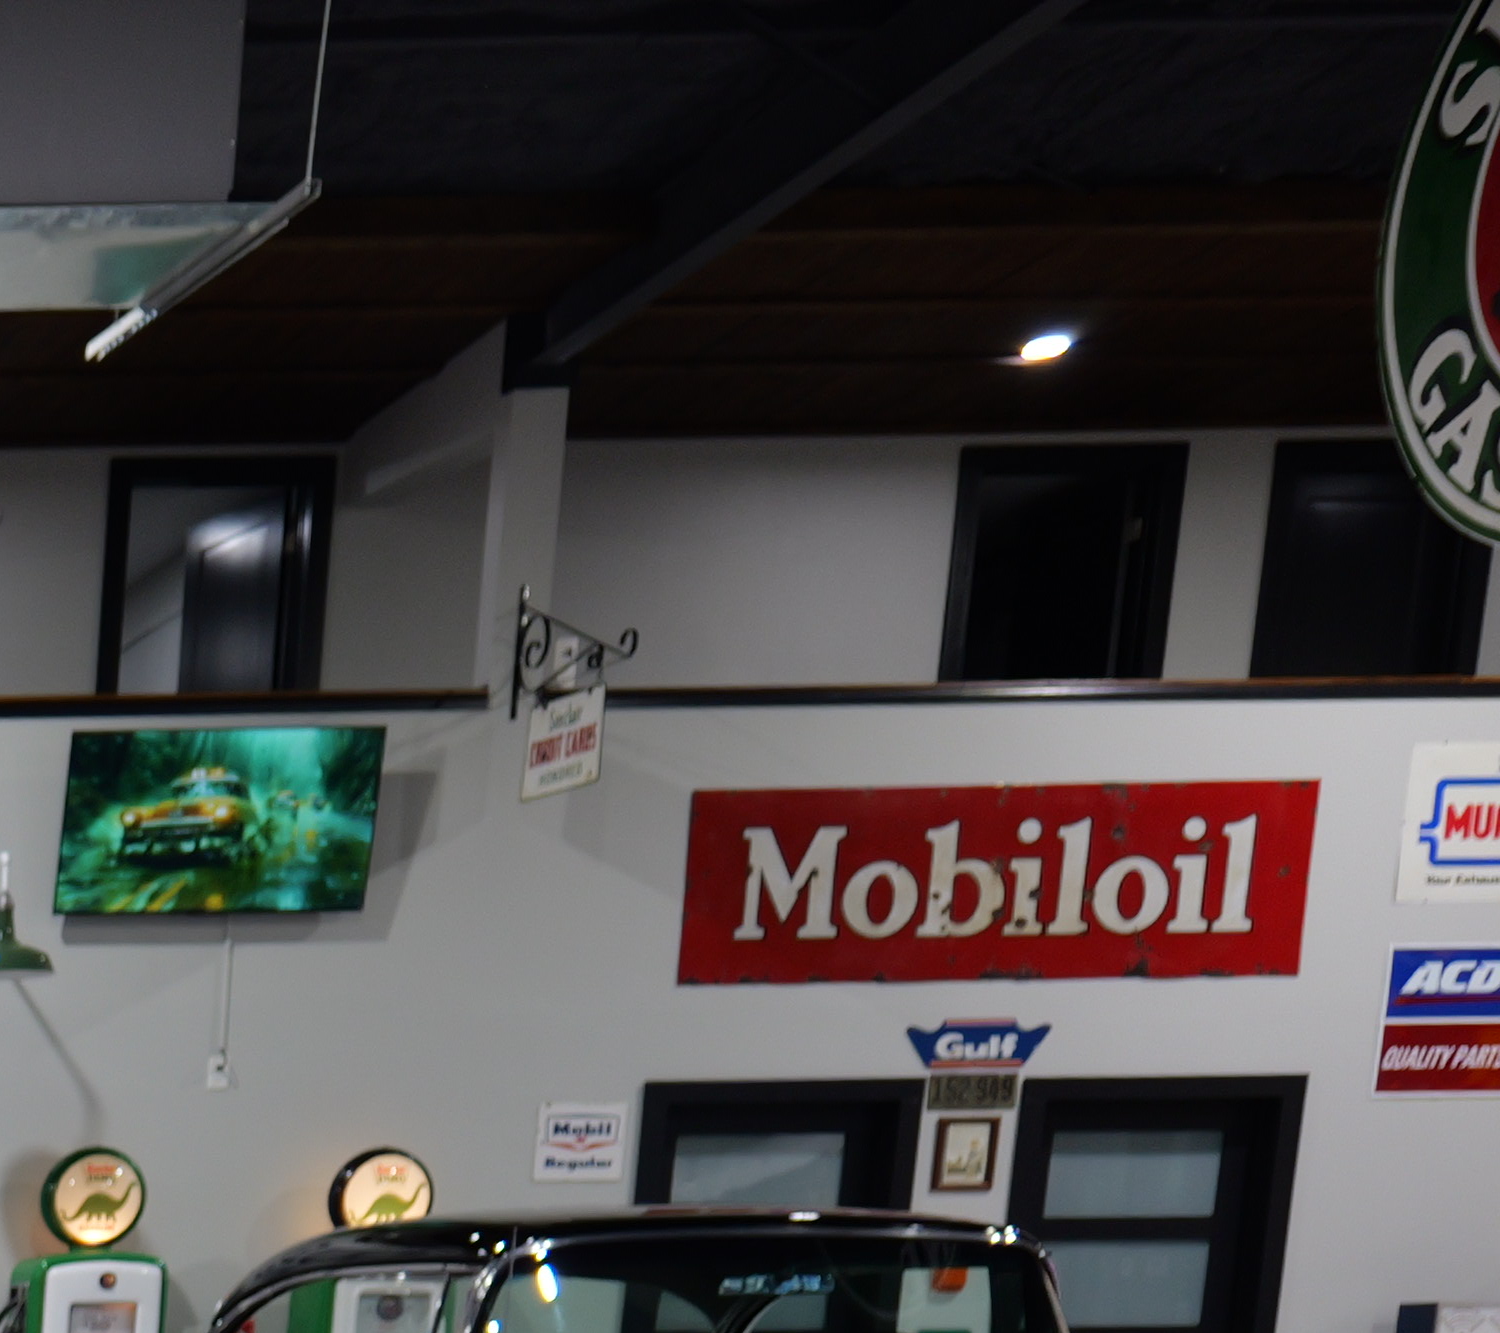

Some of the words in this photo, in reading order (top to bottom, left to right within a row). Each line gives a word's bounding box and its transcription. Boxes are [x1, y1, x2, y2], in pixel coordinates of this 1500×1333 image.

[733, 811, 1260, 942] Mobiloil
[934, 1030, 1019, 1060] Gulf
[1380, 1044, 1456, 1071] QUALITY
[553, 1121, 612, 1137] Mobil
